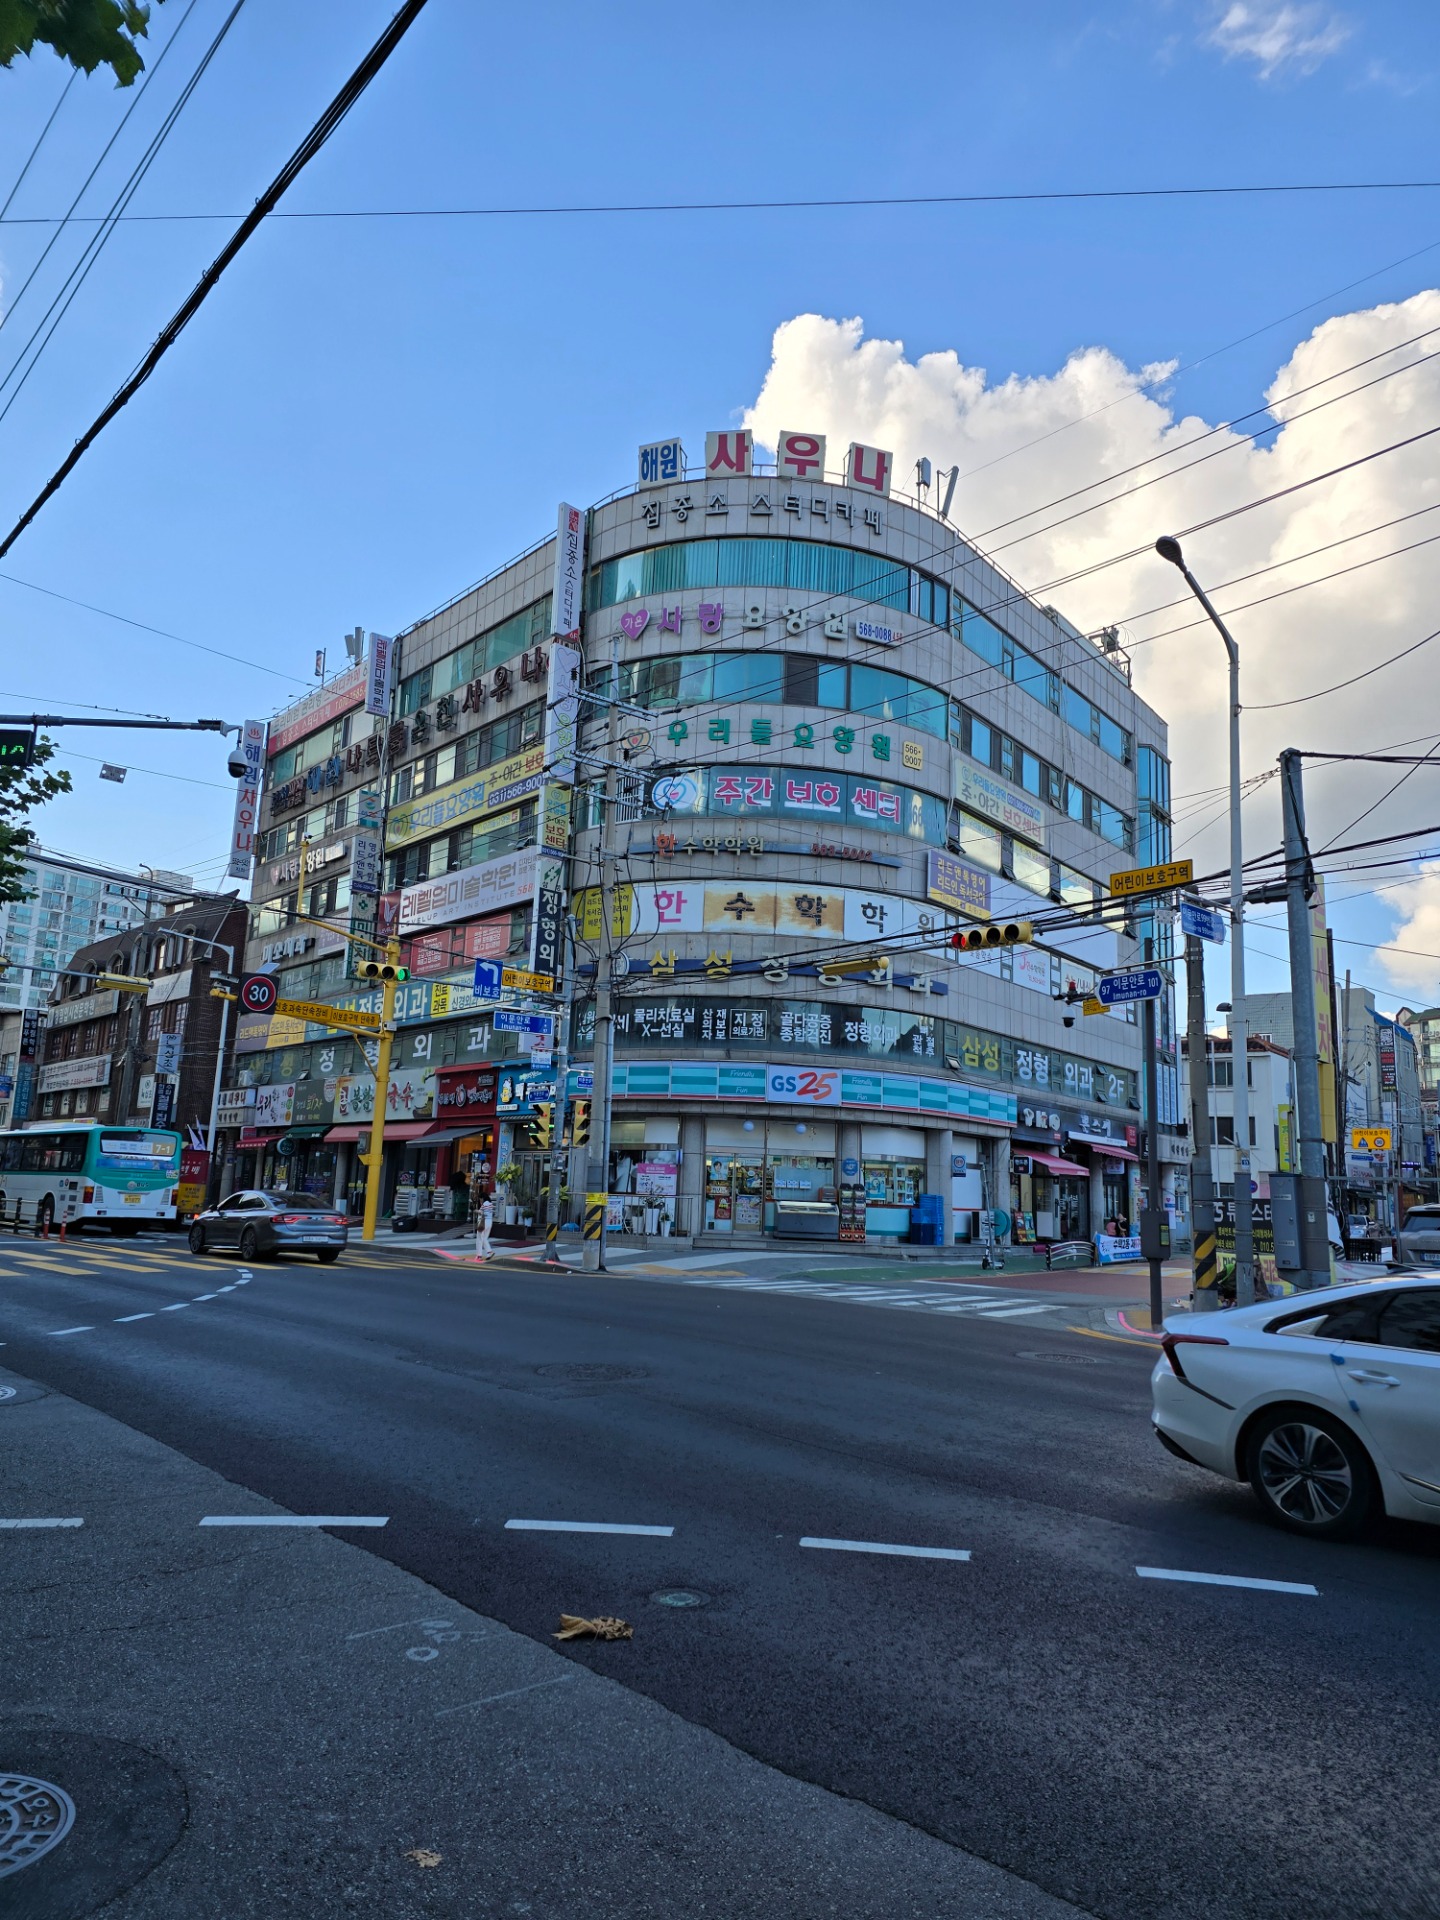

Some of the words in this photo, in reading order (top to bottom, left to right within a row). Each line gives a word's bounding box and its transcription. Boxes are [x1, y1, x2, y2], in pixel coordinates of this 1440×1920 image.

[641, 443, 678, 483] 해원
[708, 432, 889, 492] 사우나
[641, 494, 729, 528] 집중소
[750, 493, 882, 535] 스터디카페
[564, 531, 578, 580] 집중소
[563, 580, 574, 629] 스터디카페
[624, 616, 645, 628] 가은
[657, 602, 724, 634] 사랑
[742, 605, 849, 641] 요양원
[858, 621, 892, 642] 568-0088
[461, 646, 542, 714] 사우나
[667, 719, 891, 762] 우리들요양원
[904, 754, 922, 767] 9007
[409, 780, 485, 834] 우리들요양원
[714, 776, 775, 806] 주간
[785, 780, 841, 808] 보호
[851, 787, 901, 824] 센터
[236, 788, 256, 852] 사우나
[545, 825, 565, 837] 보호
[545, 834, 565, 848] 센터
[656, 835, 765, 857] 한수학학원
[1114, 864, 1189, 891] 어린이보호구역
[402, 861, 517, 919] 레벨업미술학원
[442, 905, 460, 916] ART
[539, 892, 559, 977] 정형외
[648, 950, 734, 981] 삼성
[433, 984, 447, 997] 진료
[474, 984, 500, 998] 비보호
[505, 973, 551, 991] 어린이보호구역
[1101, 985, 1111, 996] 97
[1112, 973, 1146, 991] 이문안로
[1147, 976, 1159, 988] 101
[249, 985, 269, 1003] 30
[1112, 988, 1147, 1001] Imunan-ro
[500, 1013, 531, 1025] 이문안로
[633, 1008, 696, 1023] 물리치료실
[779, 1012, 832, 1029] 골다공증
[501, 1023, 531, 1033] Imunan-ro
[732, 1026, 765, 1038] 의료기관
[779, 1028, 832, 1045] 종합검진
[844, 1021, 897, 1046] 정형외과
[729, 1069, 755, 1079] Friendly
[961, 1035, 999, 1072] 삼성
[1016, 1049, 1050, 1085] 정형
[1064, 1061, 1094, 1093] 외과
[1108, 1075, 1125, 1099] 2F
[735, 1086, 748, 1095] Fun
[770, 1071, 838, 1101] GS25
[155, 1144, 171, 1154] 7-1
